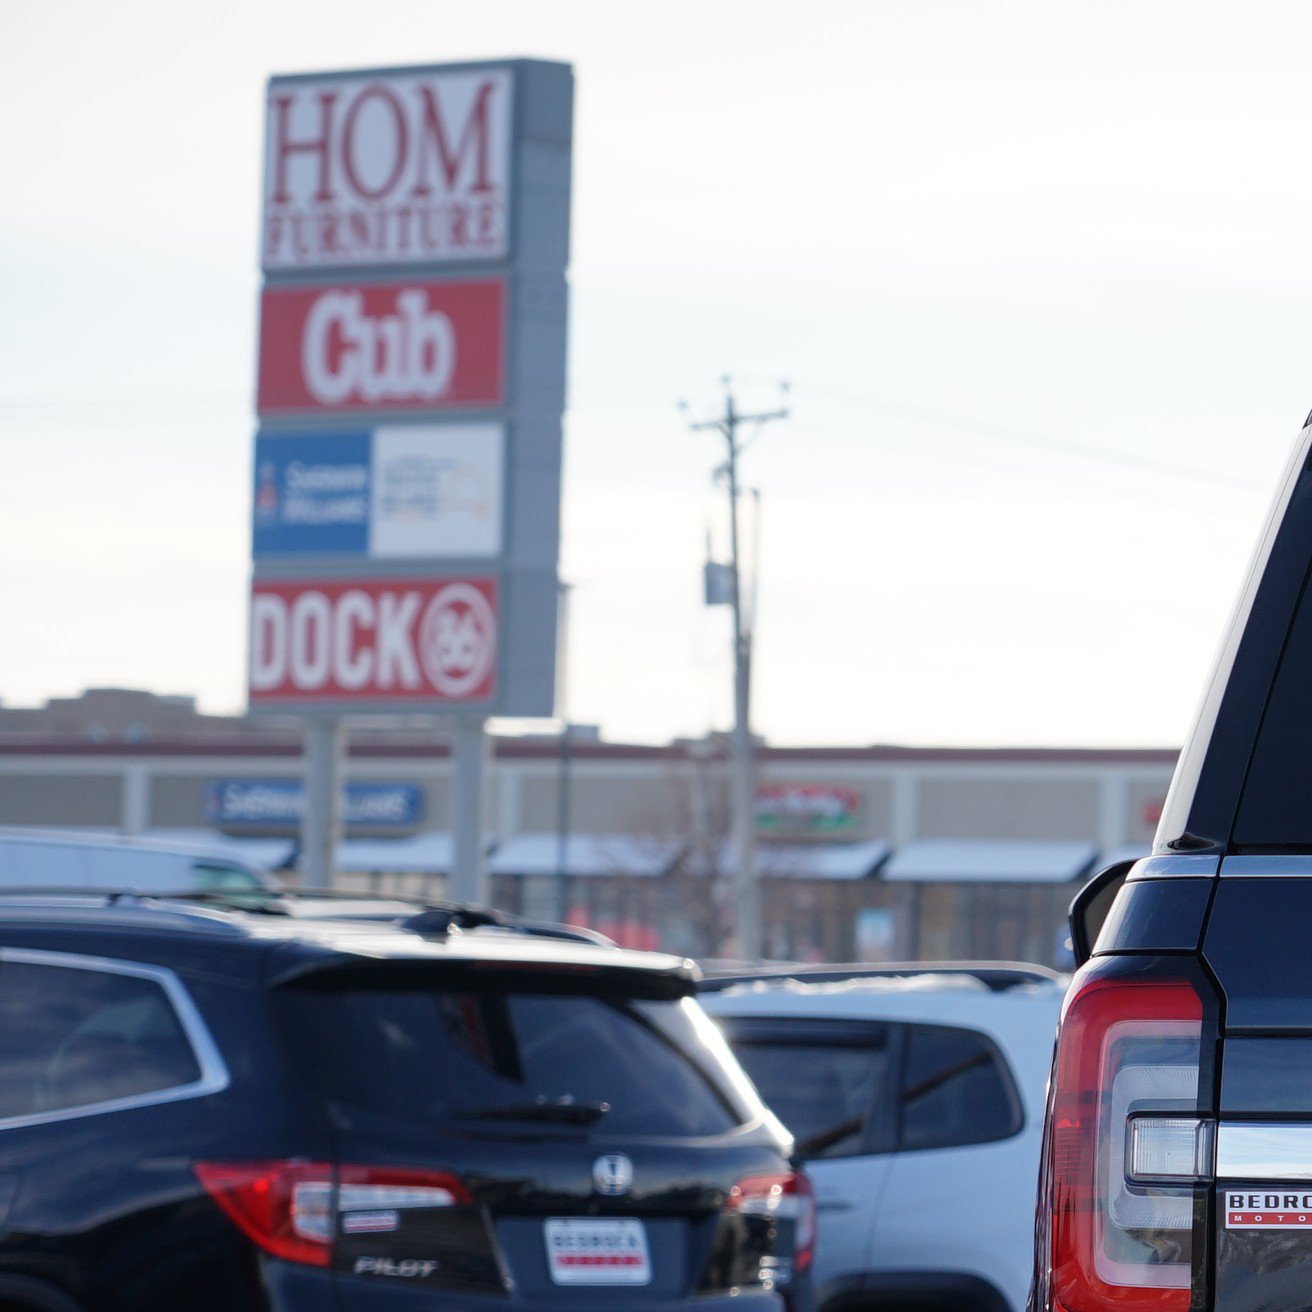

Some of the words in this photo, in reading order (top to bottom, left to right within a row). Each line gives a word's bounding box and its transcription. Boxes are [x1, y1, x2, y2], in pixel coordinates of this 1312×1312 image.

[271, 80, 495, 203] HOM
[267, 202, 499, 254] FURNITURE
[303, 288, 456, 402] Cub
[251, 588, 421, 692] DOCK
[354, 1256, 438, 1277] PILOT
